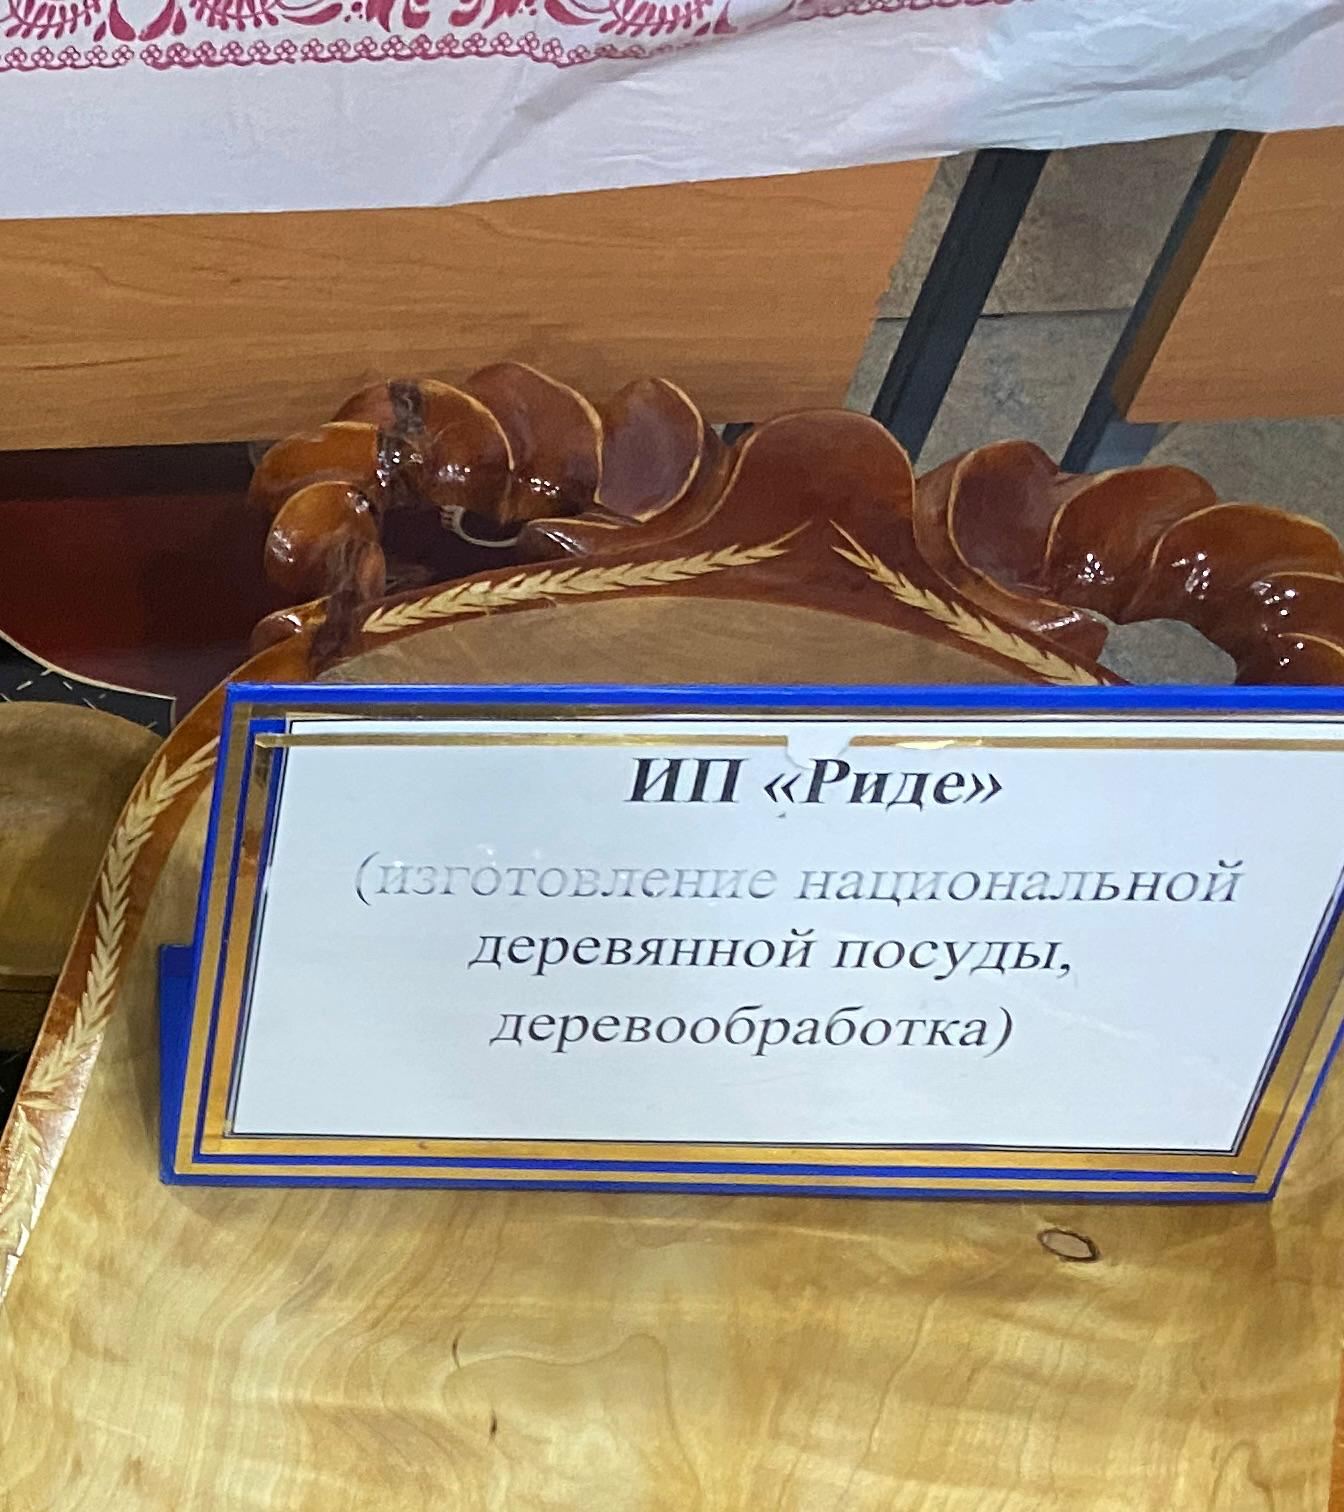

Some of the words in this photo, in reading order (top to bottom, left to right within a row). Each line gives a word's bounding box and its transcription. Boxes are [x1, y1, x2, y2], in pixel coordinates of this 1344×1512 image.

[625, 757, 747, 803] ИП
[764, 757, 1002, 810] «Риде»
[356, 852, 777, 908] (изготовление
[795, 859, 1244, 906] национальной
[469, 929, 815, 975] деревянной
[832, 935, 1072, 981] посуды,
[489, 1004, 1014, 1056] деревообработка)
